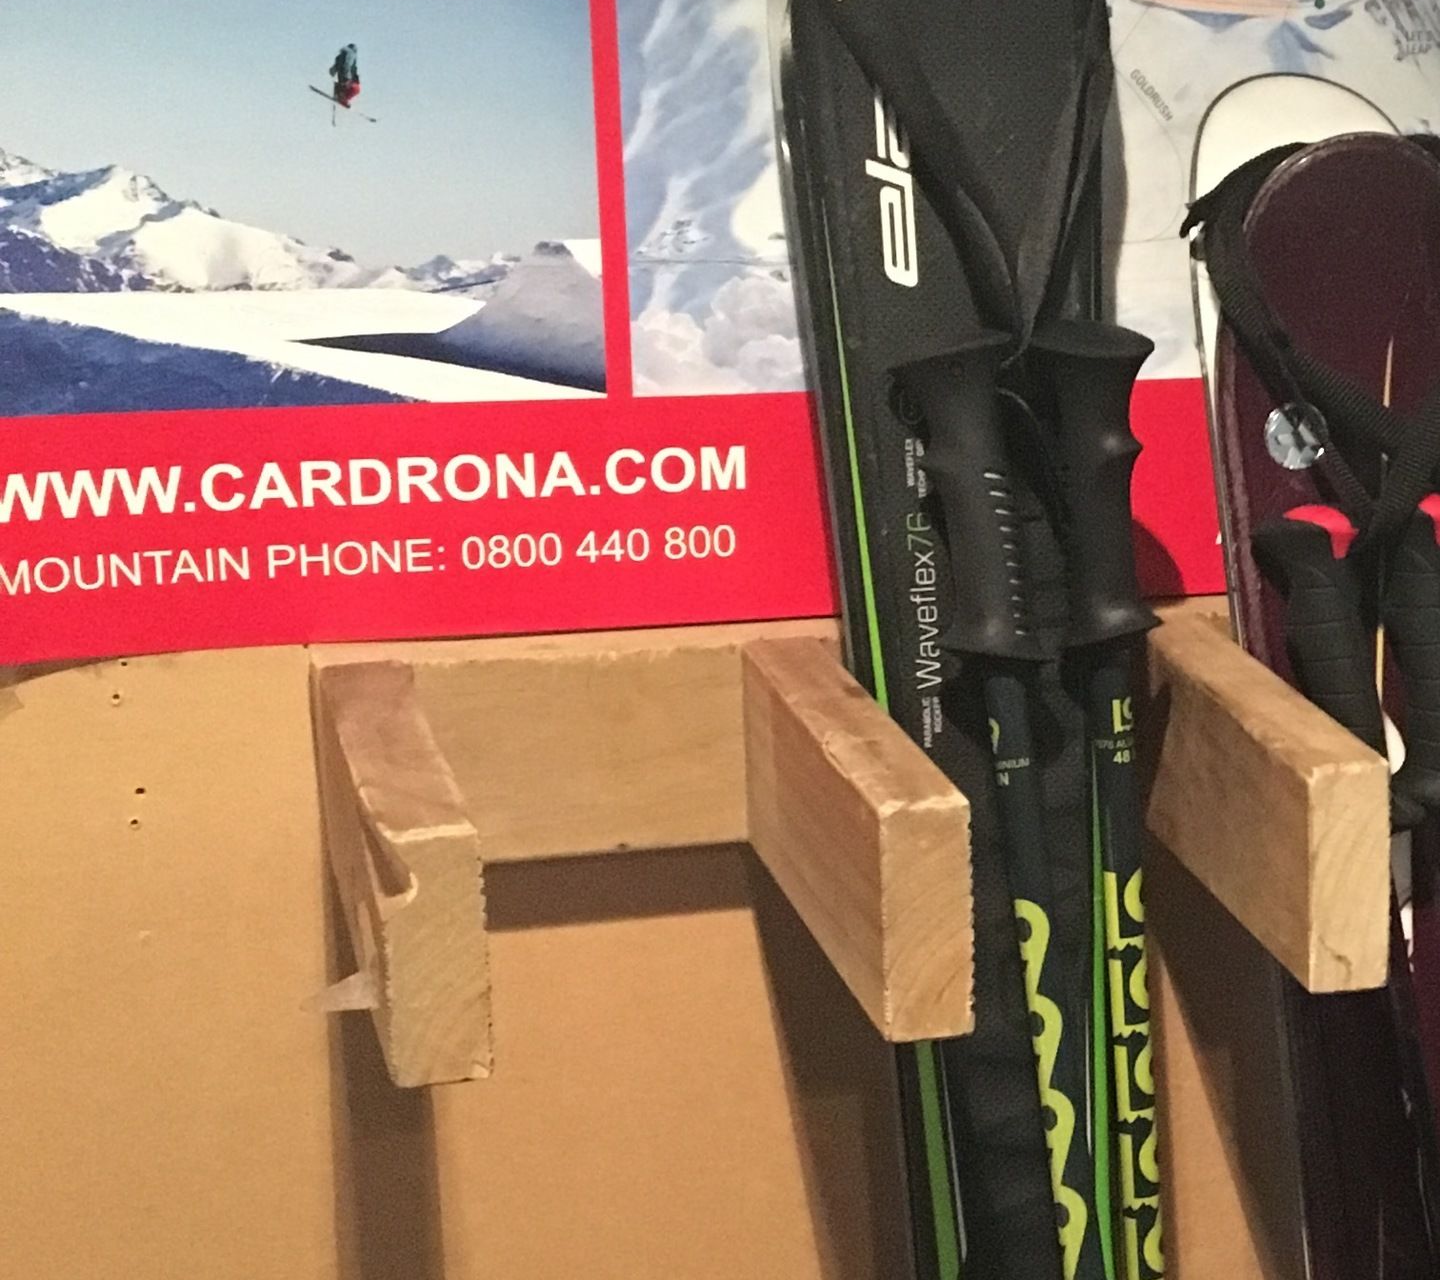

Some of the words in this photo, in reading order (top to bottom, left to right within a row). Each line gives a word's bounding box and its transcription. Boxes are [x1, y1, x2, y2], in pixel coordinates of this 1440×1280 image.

[1129, 67, 1174, 123] GOLDRUSH
[0, 445, 748, 523] WWW.CARDRONA.COM
[0, 545, 252, 598] MOUNTAIN
[266, 537, 448, 584] PHONE:
[460, 531, 563, 573] 0800
[575, 527, 651, 566] 440
[663, 523, 737, 560] 800
